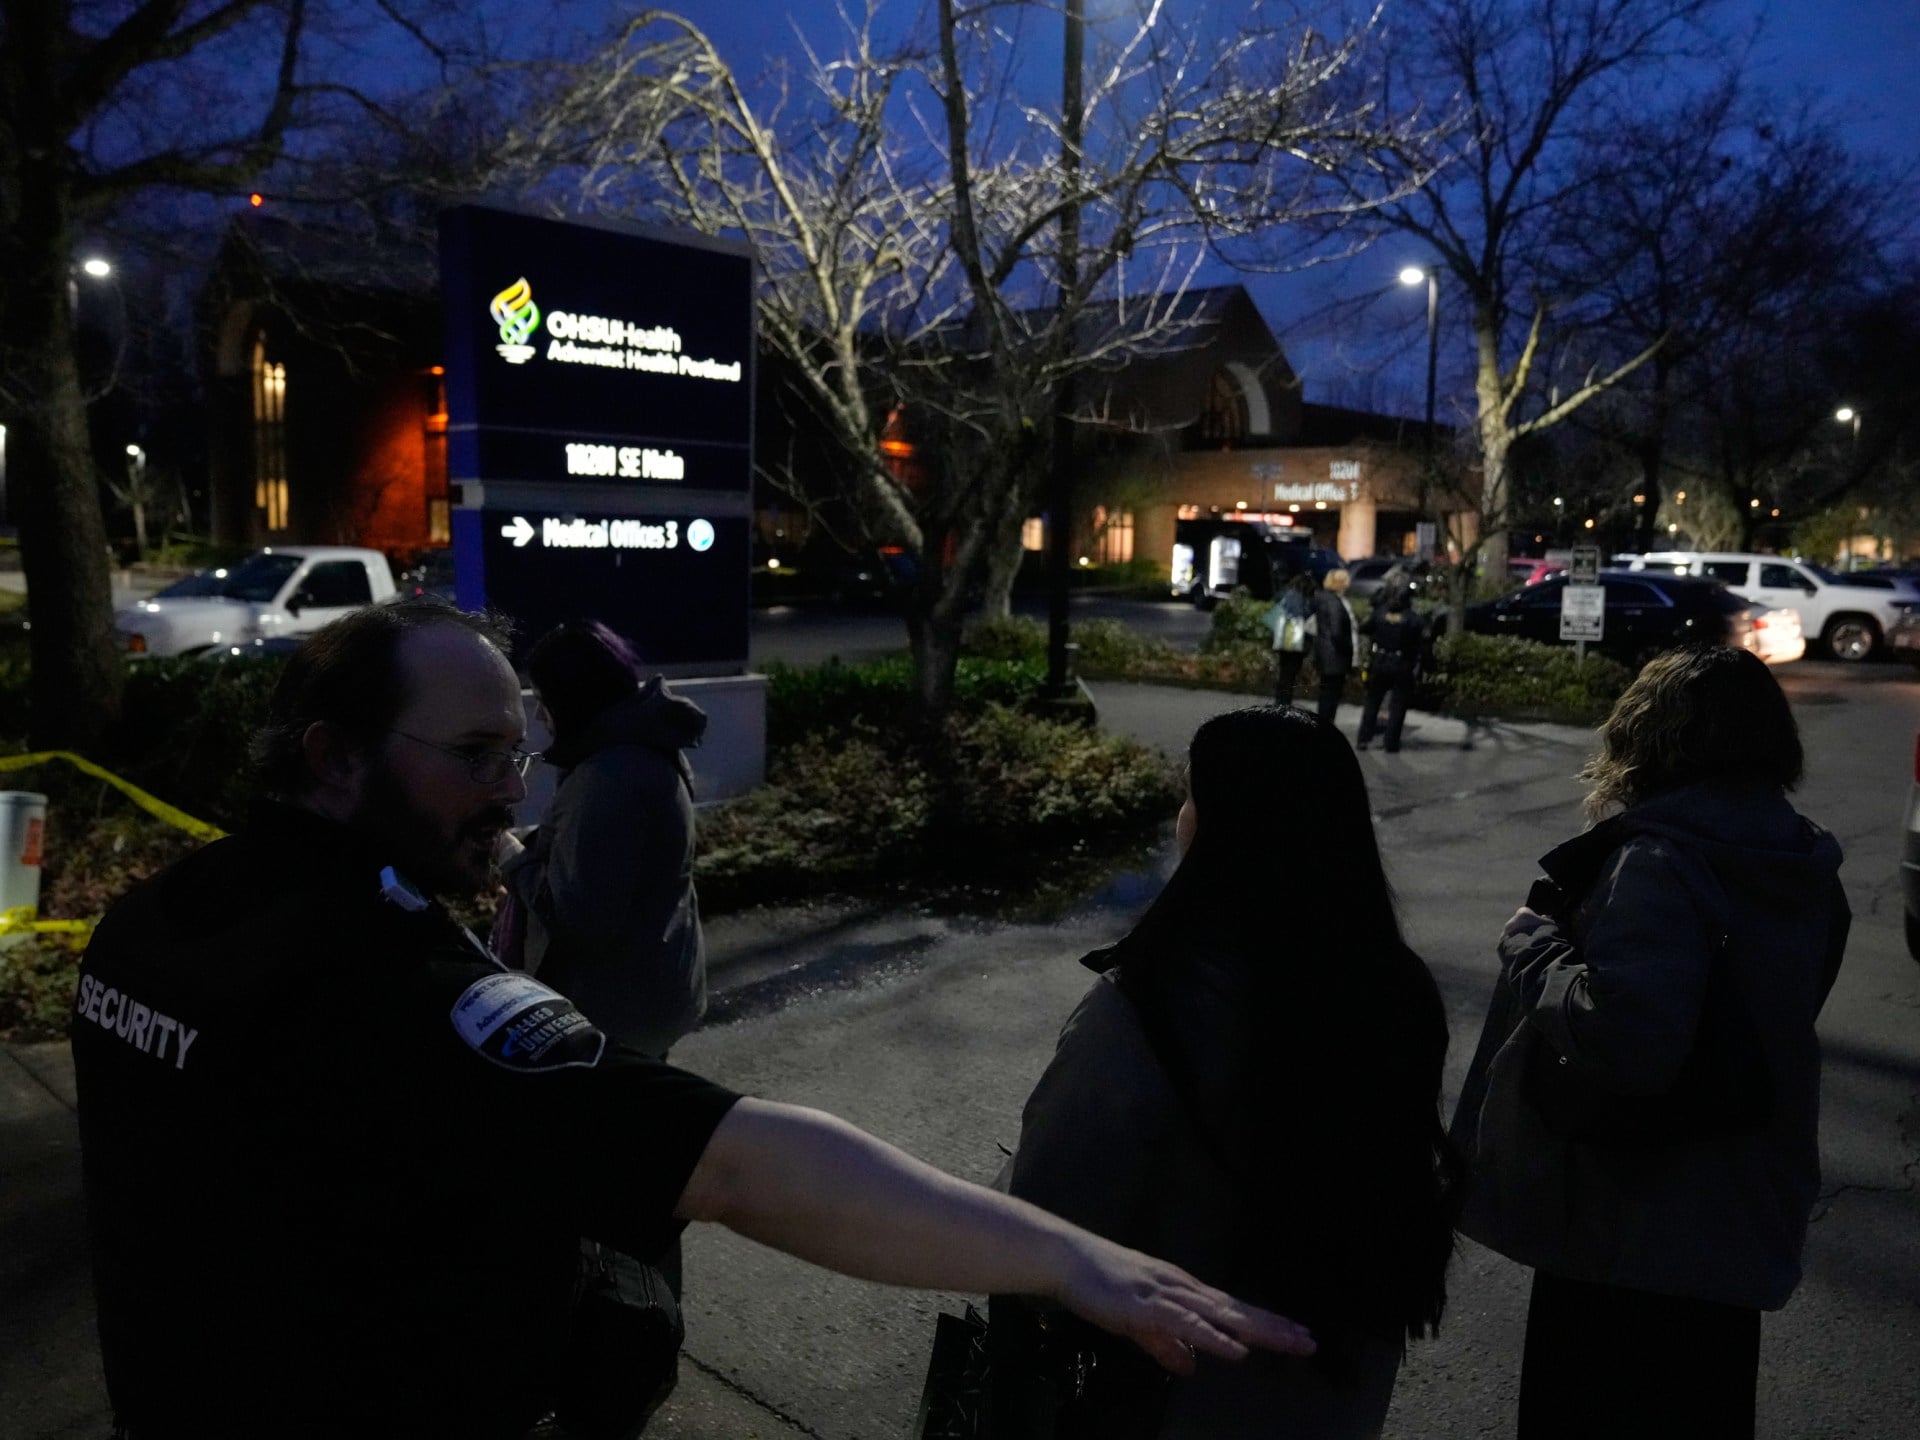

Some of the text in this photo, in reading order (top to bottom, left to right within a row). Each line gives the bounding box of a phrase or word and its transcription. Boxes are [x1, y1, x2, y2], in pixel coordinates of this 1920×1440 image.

[547, 311, 681, 352] OHSU Health
[548, 340, 741, 381] Adventist Health Portland
[619, 448, 641, 477] SE
[643, 450, 684, 479] Main
[1274, 482, 1314, 502] Medical
[543, 518, 608, 547] Medical
[610, 520, 665, 548] Offices
[77, 973, 199, 1070] SECURITY
